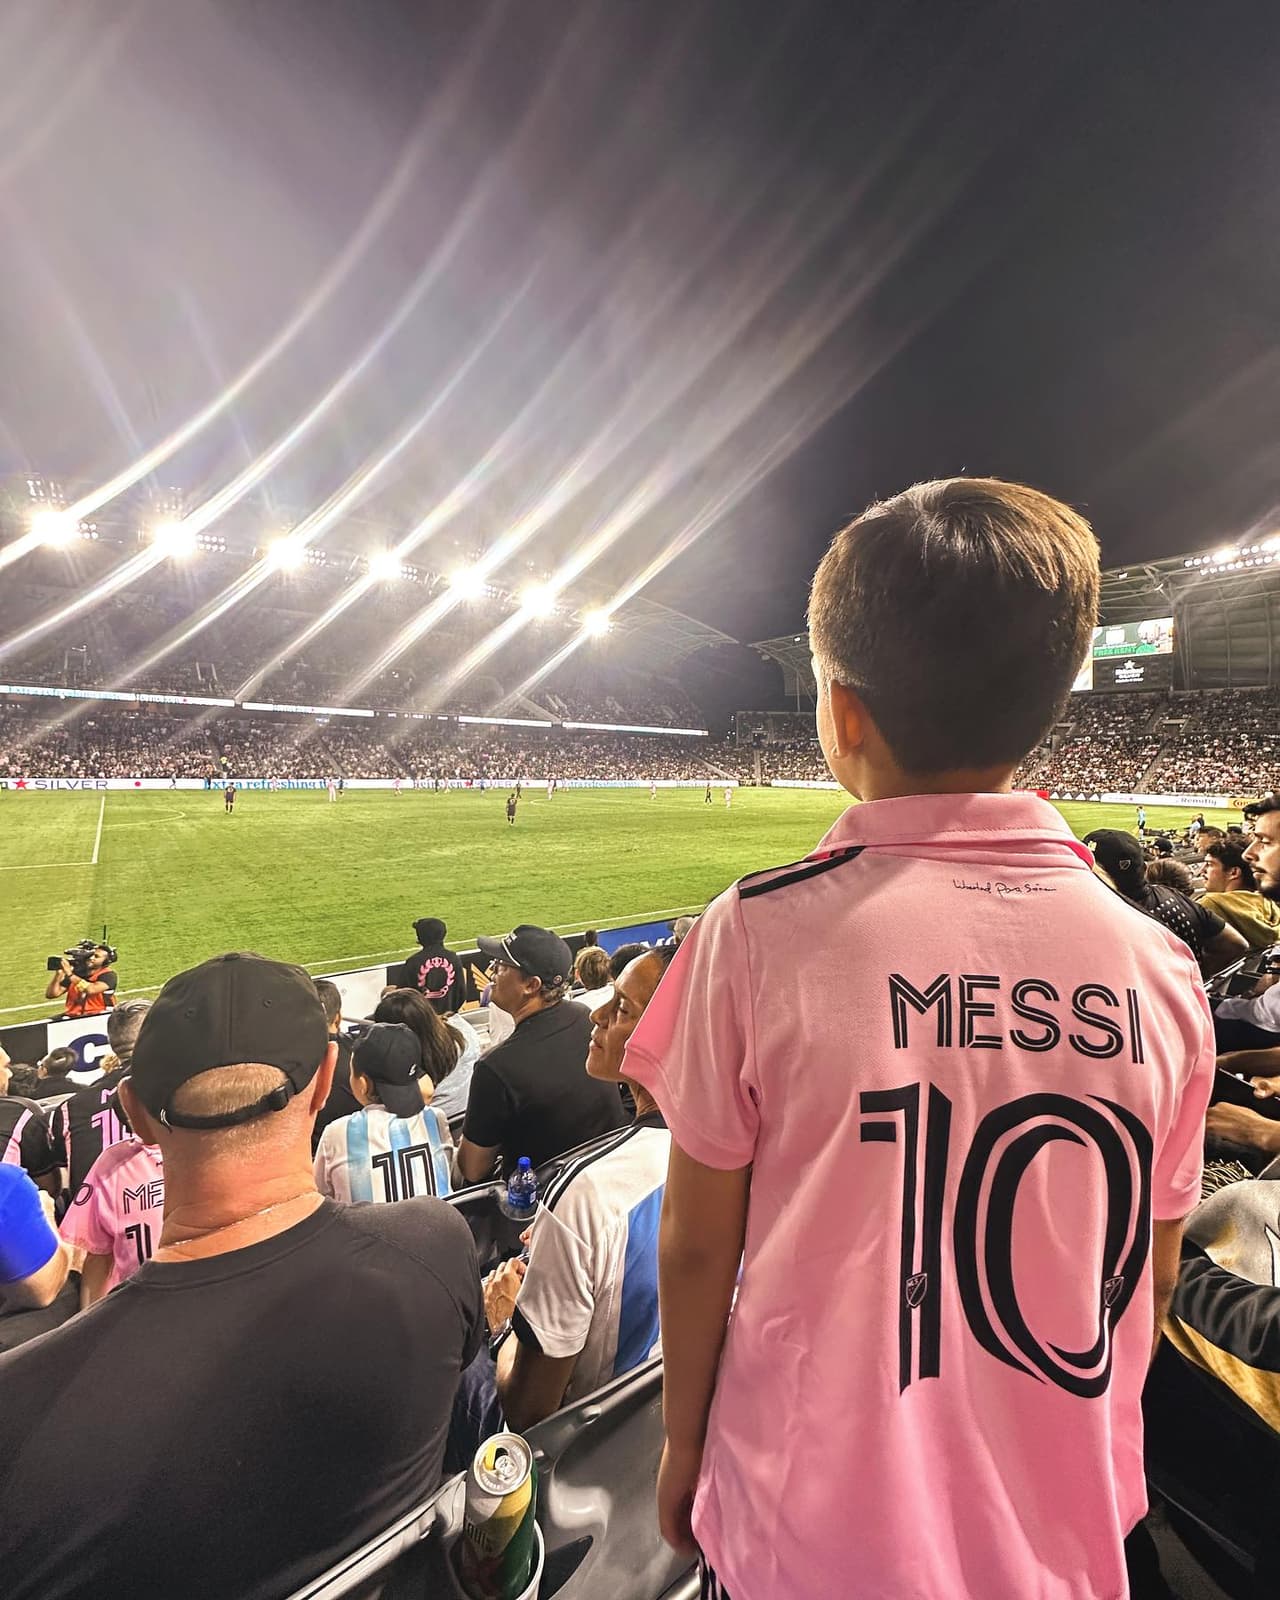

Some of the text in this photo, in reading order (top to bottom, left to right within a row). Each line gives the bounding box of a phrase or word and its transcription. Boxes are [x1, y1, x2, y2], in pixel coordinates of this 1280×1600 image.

[35, 780, 108, 790] SILVER
[204, 776, 242, 790] Exta
[888, 973, 1145, 1064] MESSI
[371, 1142, 437, 1203] 10
[860, 1081, 1154, 1399] 10
